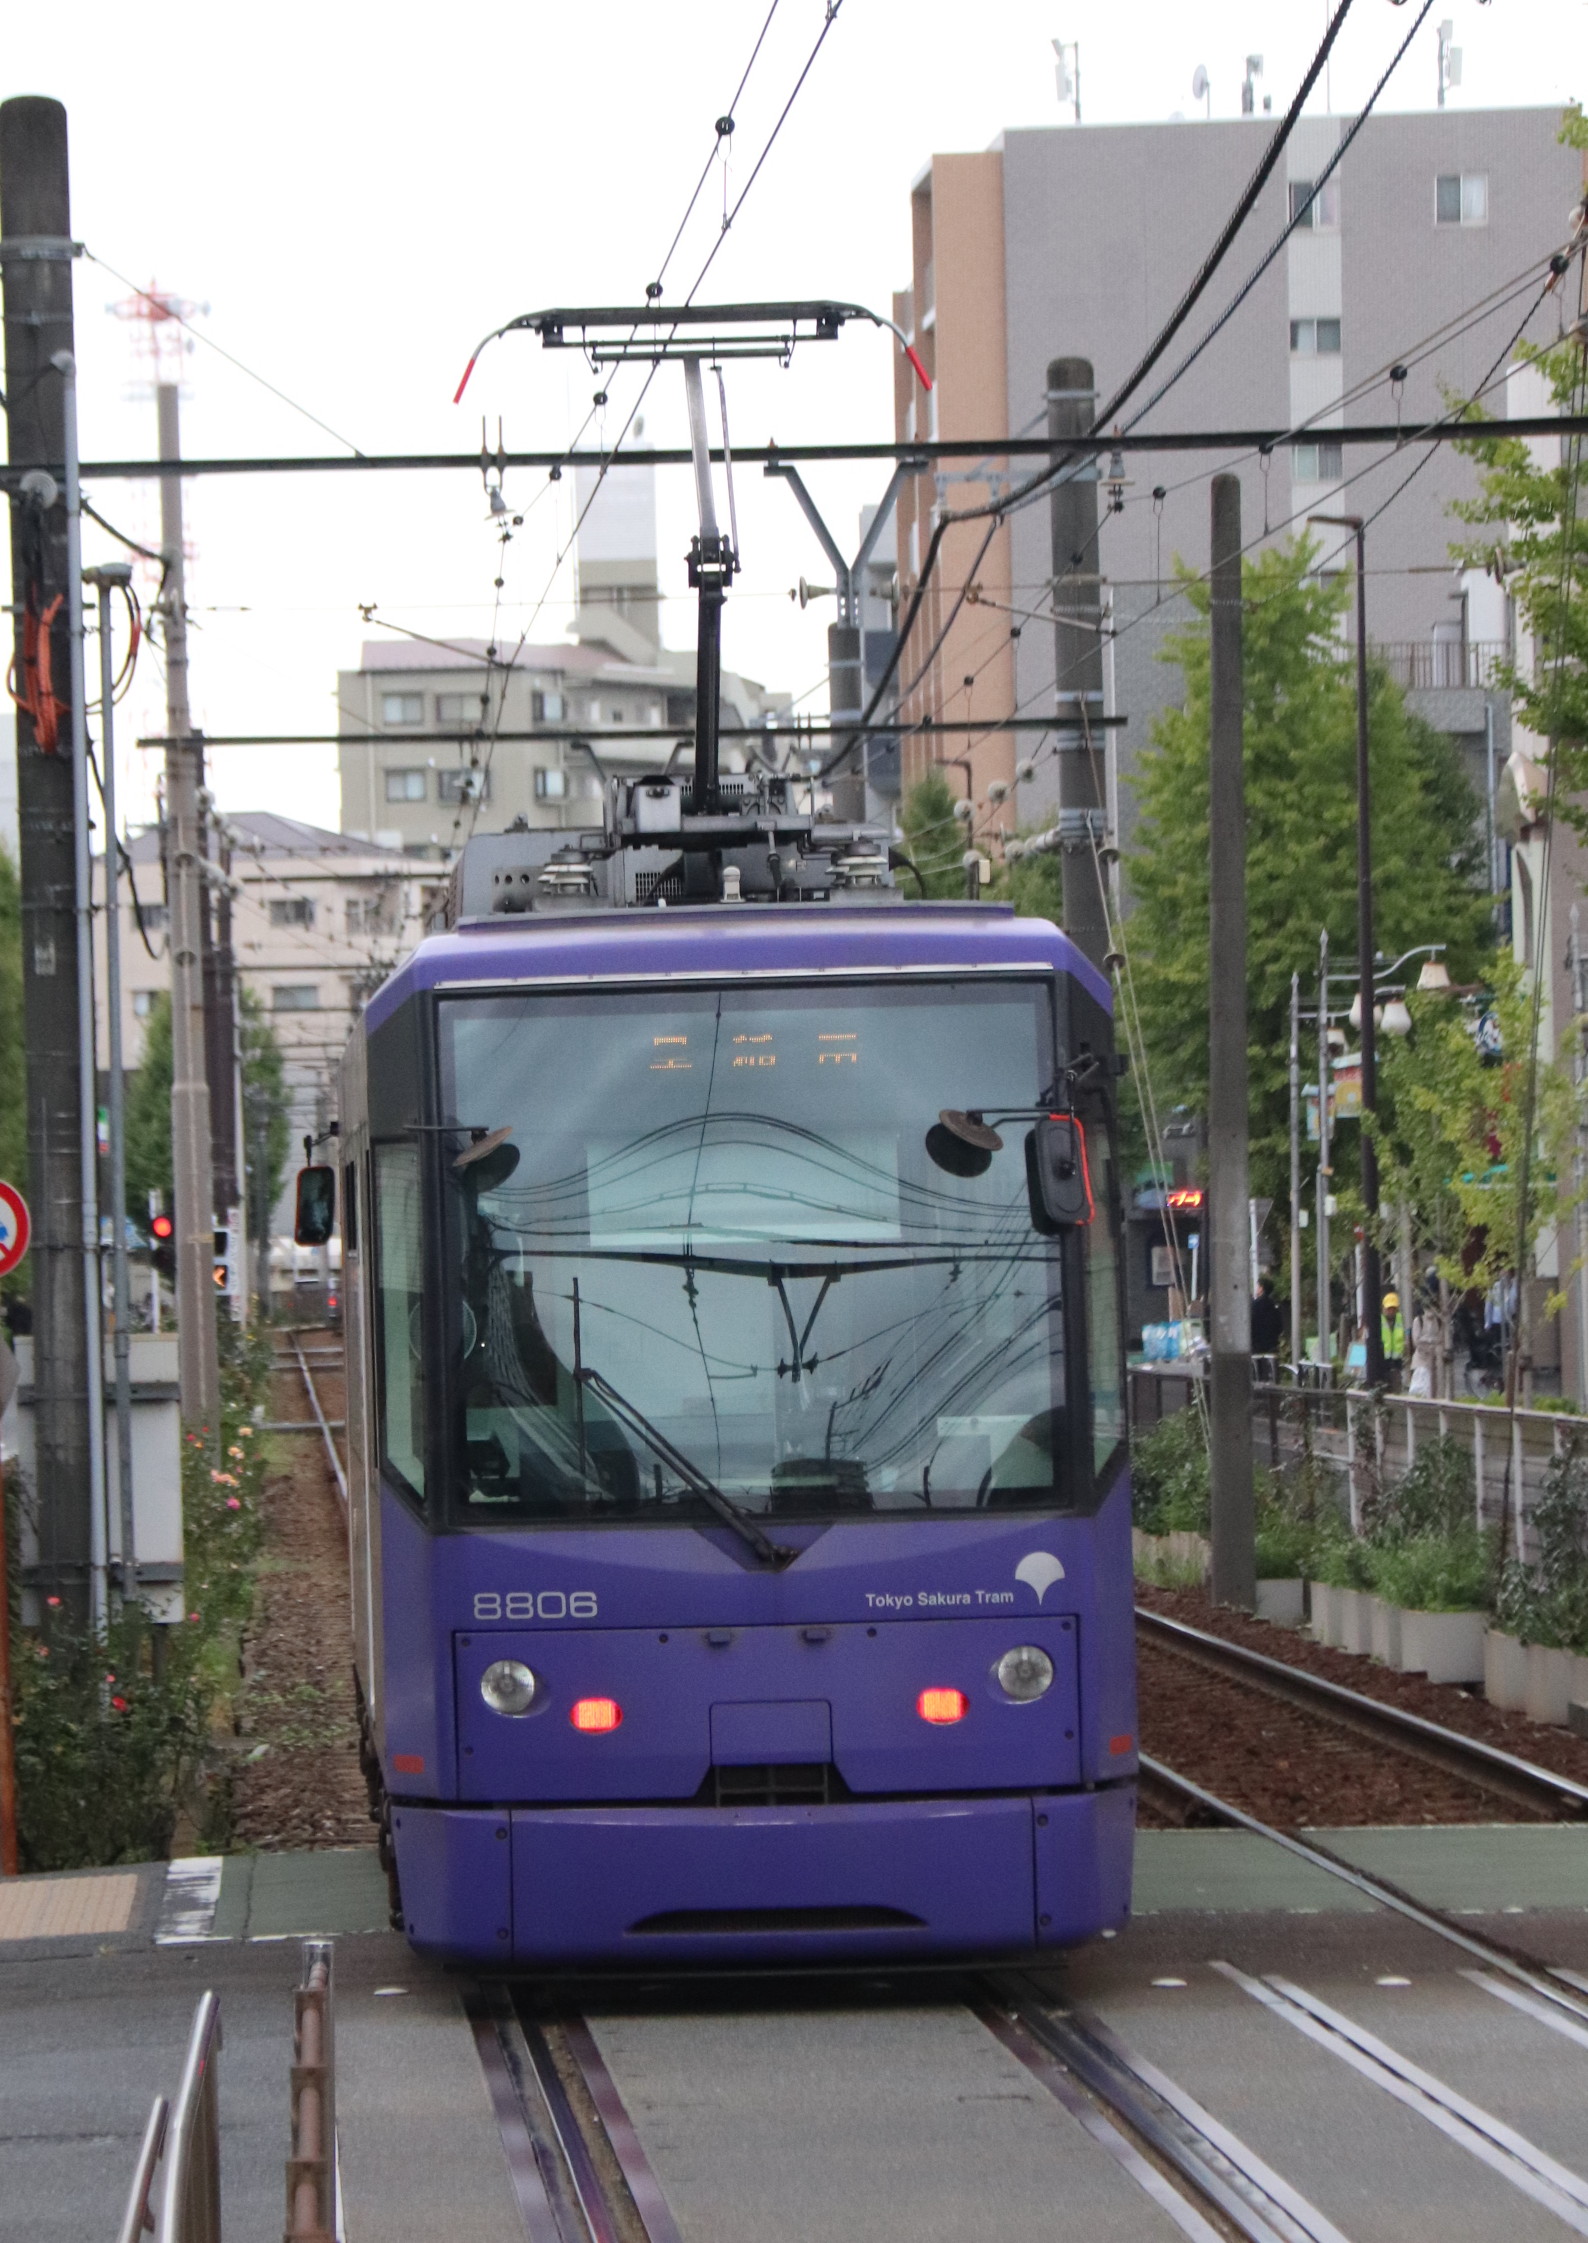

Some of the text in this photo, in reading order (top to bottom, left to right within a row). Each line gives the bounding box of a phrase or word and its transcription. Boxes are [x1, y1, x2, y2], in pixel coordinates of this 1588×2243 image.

[473, 1591, 598, 1620] 8806
[865, 1590, 1014, 1610] Tokyo Sakura Tram
